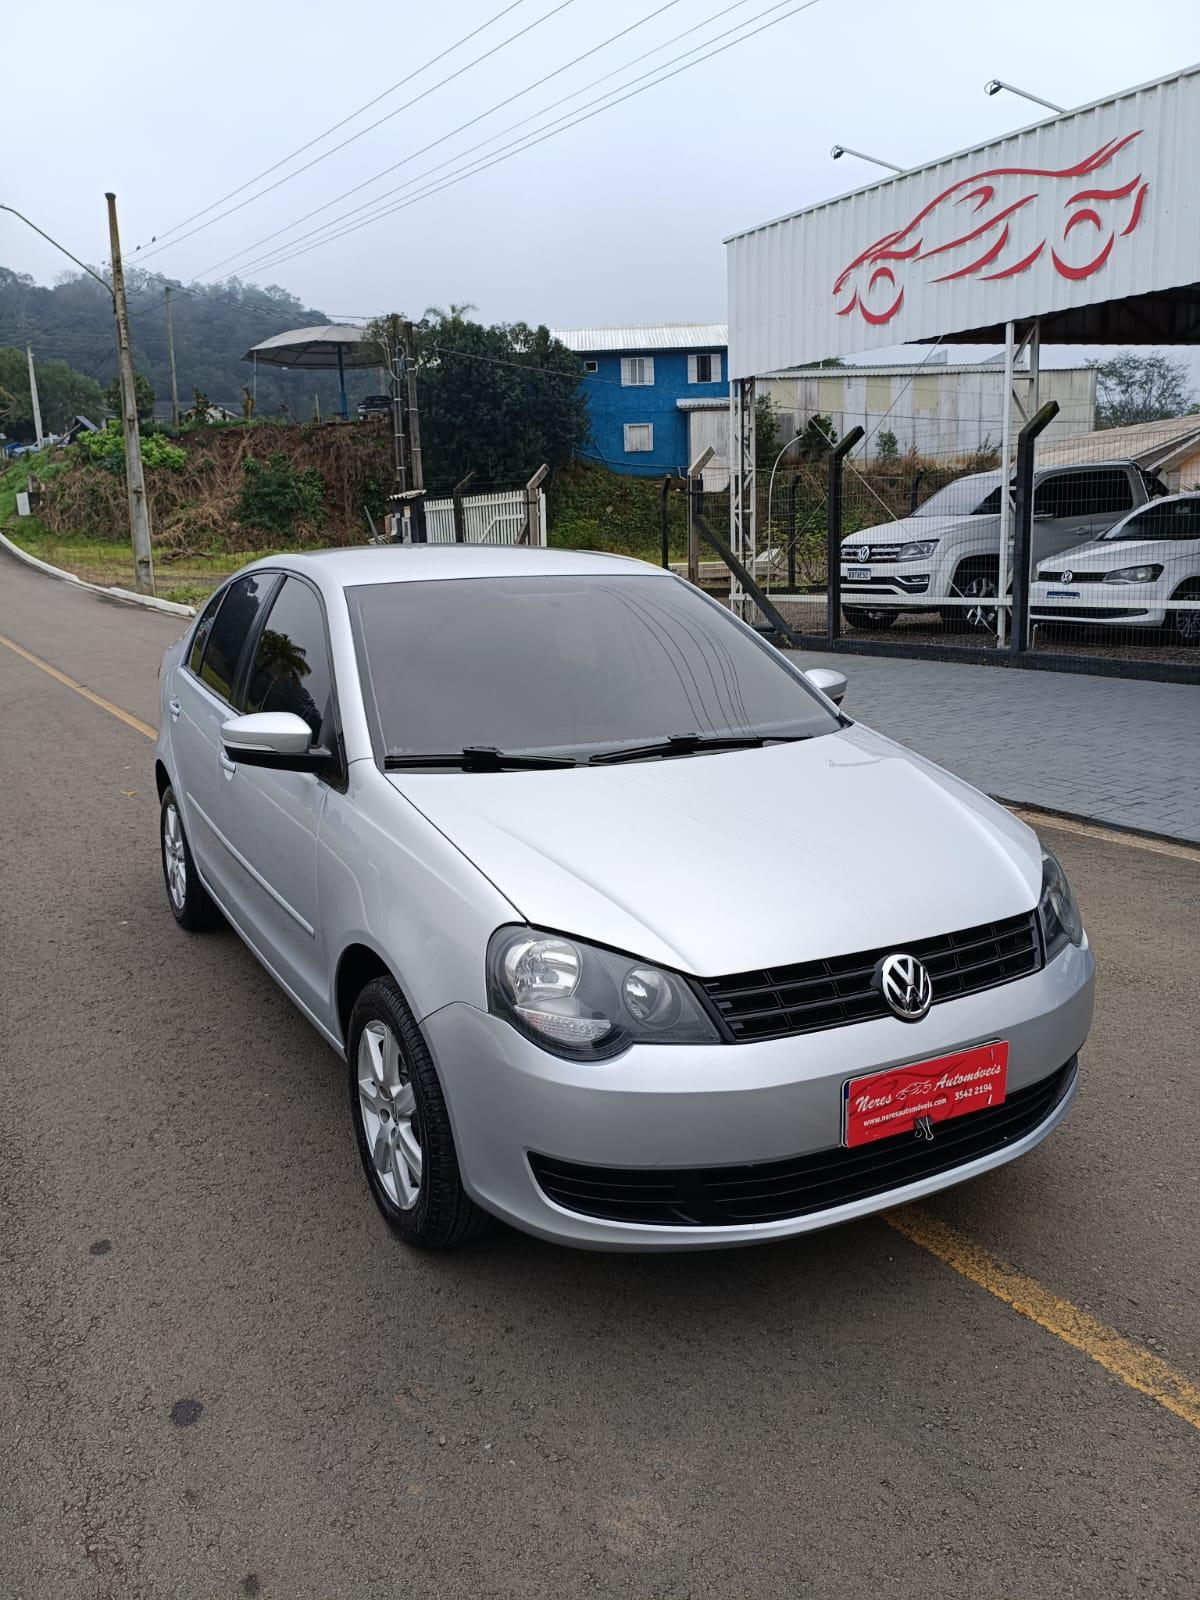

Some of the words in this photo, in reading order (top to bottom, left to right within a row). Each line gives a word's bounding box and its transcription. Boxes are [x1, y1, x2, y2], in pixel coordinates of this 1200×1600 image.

[882, 954, 931, 1018] VW
[855, 1095, 893, 1112] Neres
[933, 1064, 1001, 1091] Automóveis
[954, 1088, 973, 1101] 3542
